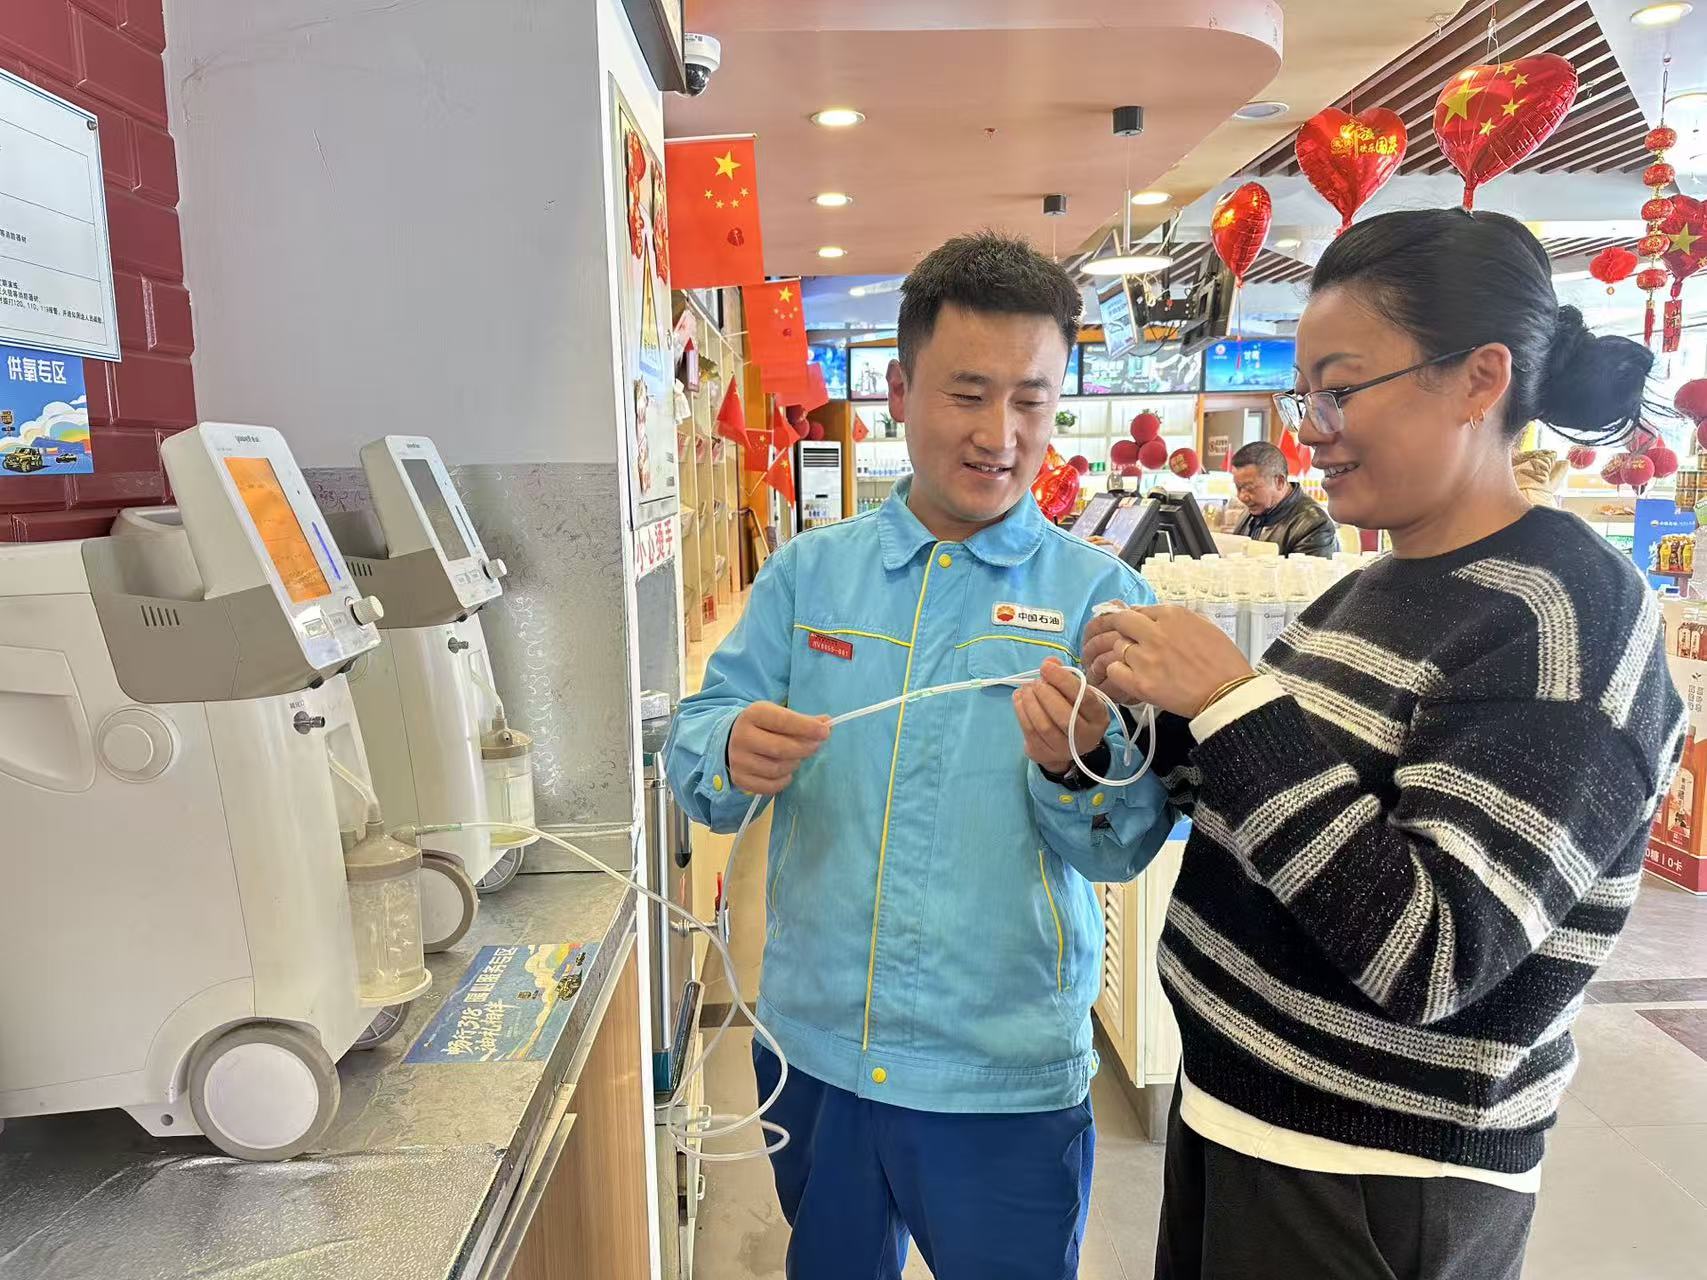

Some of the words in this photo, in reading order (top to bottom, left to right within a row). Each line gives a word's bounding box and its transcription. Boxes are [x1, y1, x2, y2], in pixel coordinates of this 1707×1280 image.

[7, 356, 67, 384] 供氧专区
[637, 518, 673, 572] 小心烫手
[1018, 612, 1059, 625] 中国石油
